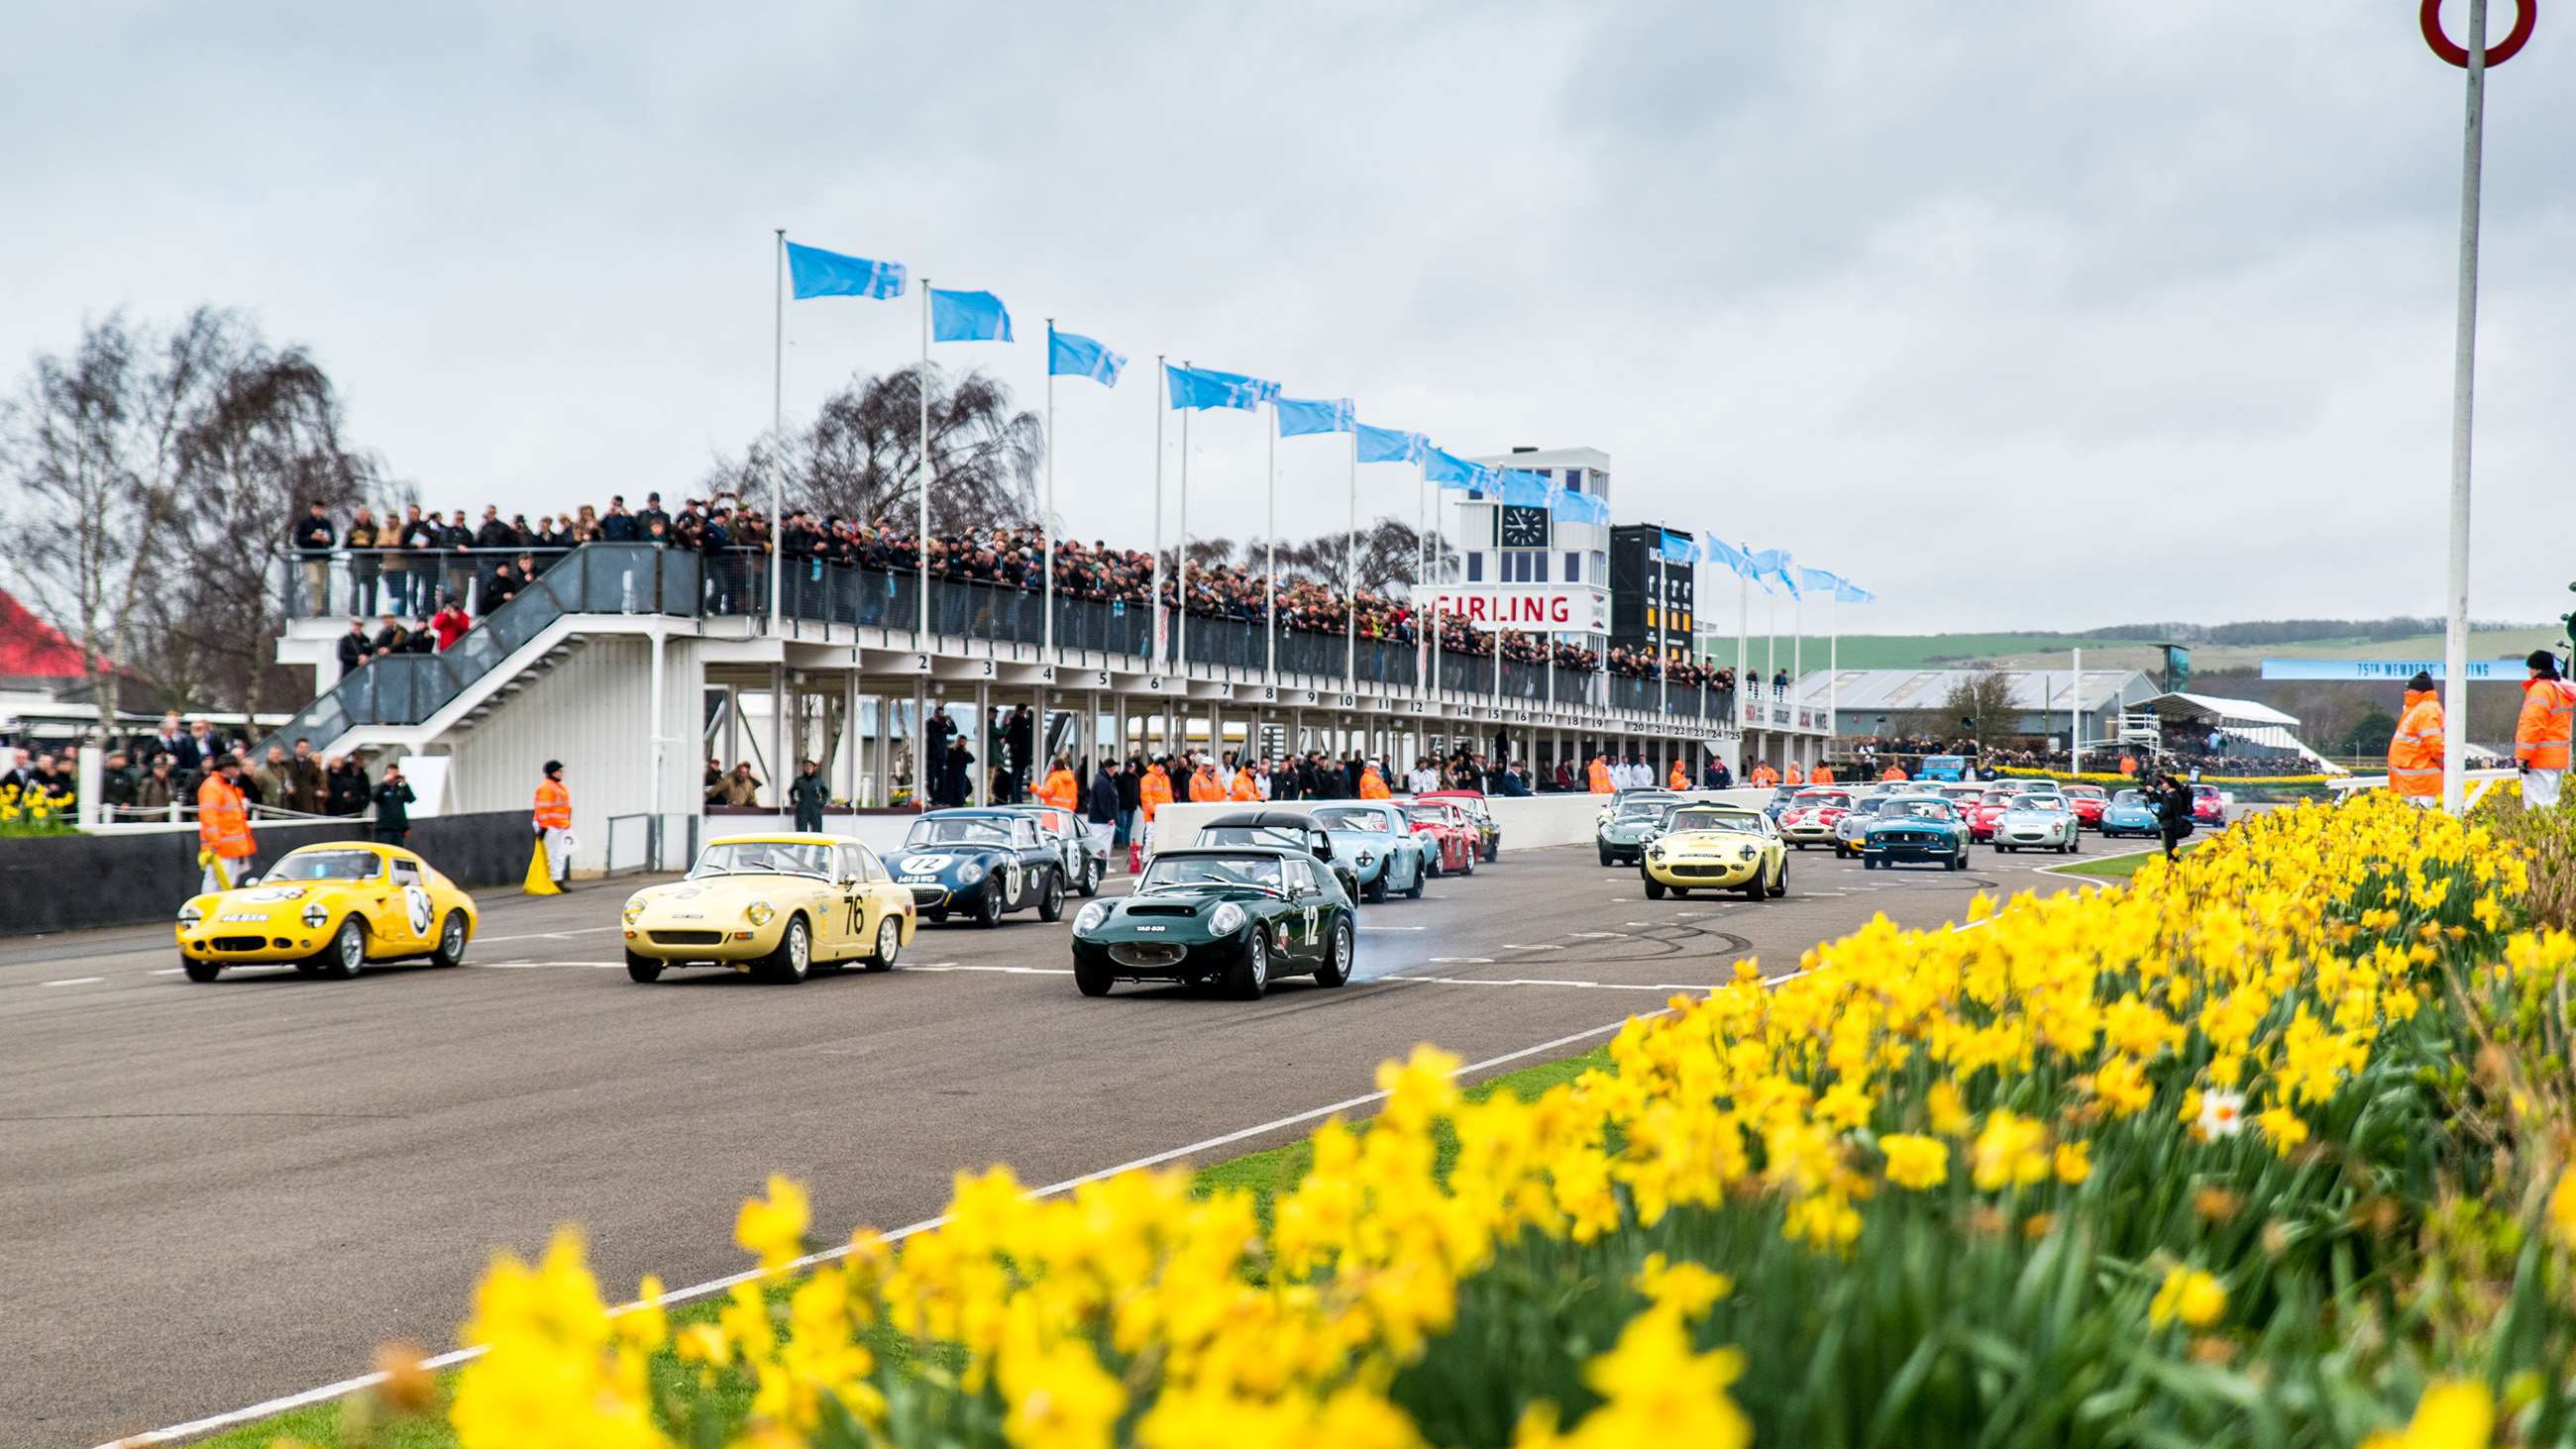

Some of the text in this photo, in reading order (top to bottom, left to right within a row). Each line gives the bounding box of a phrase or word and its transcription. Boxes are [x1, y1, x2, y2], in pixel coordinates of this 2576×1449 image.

[917, 655, 926, 670] 2
[984, 662, 992, 675] 3
[1042, 668, 1051, 680] 4
[1099, 673, 1107, 685] 5
[1150, 677, 1158, 689] 6
[1222, 683, 1230, 695] 7
[1265, 687, 1273, 699] 8
[1307, 691, 1315, 702] 9
[1340, 695, 1353, 706] 10
[1410, 701, 1423, 712] 12
[1456, 706, 1469, 716] 14
[1487, 709, 1499, 719] 15
[1514, 711, 1527, 721] 16
[1542, 712, 1554, 722] 17
[1567, 716, 1579, 726] 18
[1592, 719, 1603, 728] 19
[1633, 722, 1645, 732] 20
[1656, 725, 1665, 734] 21
[1673, 726, 1684, 736] 22
[410, 889, 434, 934] 38
[843, 895, 864, 935] 76
[1303, 905, 1319, 946] 12
